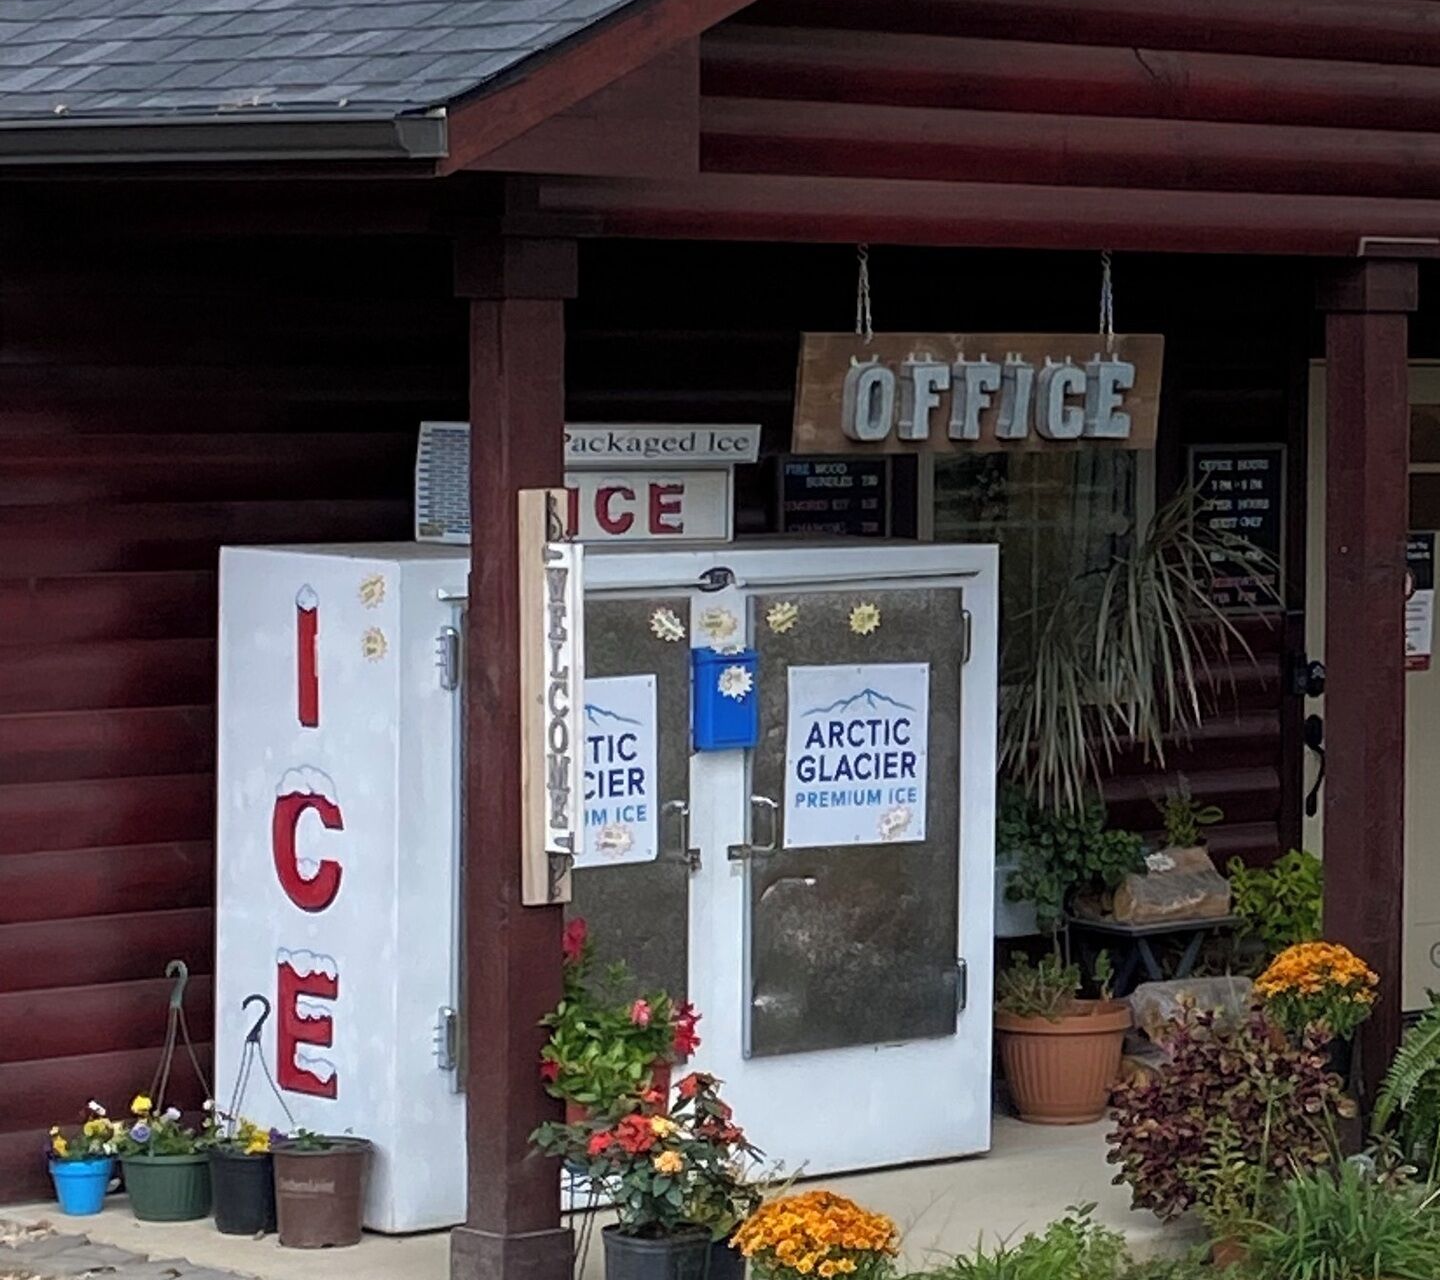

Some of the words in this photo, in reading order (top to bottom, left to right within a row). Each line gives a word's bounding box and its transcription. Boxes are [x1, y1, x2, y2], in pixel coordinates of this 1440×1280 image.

[841, 358, 1135, 441] OFFICE
[709, 432, 749, 452] Ice
[566, 478, 685, 536] ICE
[545, 567, 570, 830] WELCOME
[587, 733, 637, 764] TIC
[805, 718, 911, 749] ARCTIC
[796, 751, 917, 783] GLACIER
[584, 767, 645, 800] CIER
[794, 789, 882, 808] PREMIUM
[888, 787, 917, 805] ICE
[616, 805, 647, 822] ICE
[272, 584, 344, 1099] ICE
